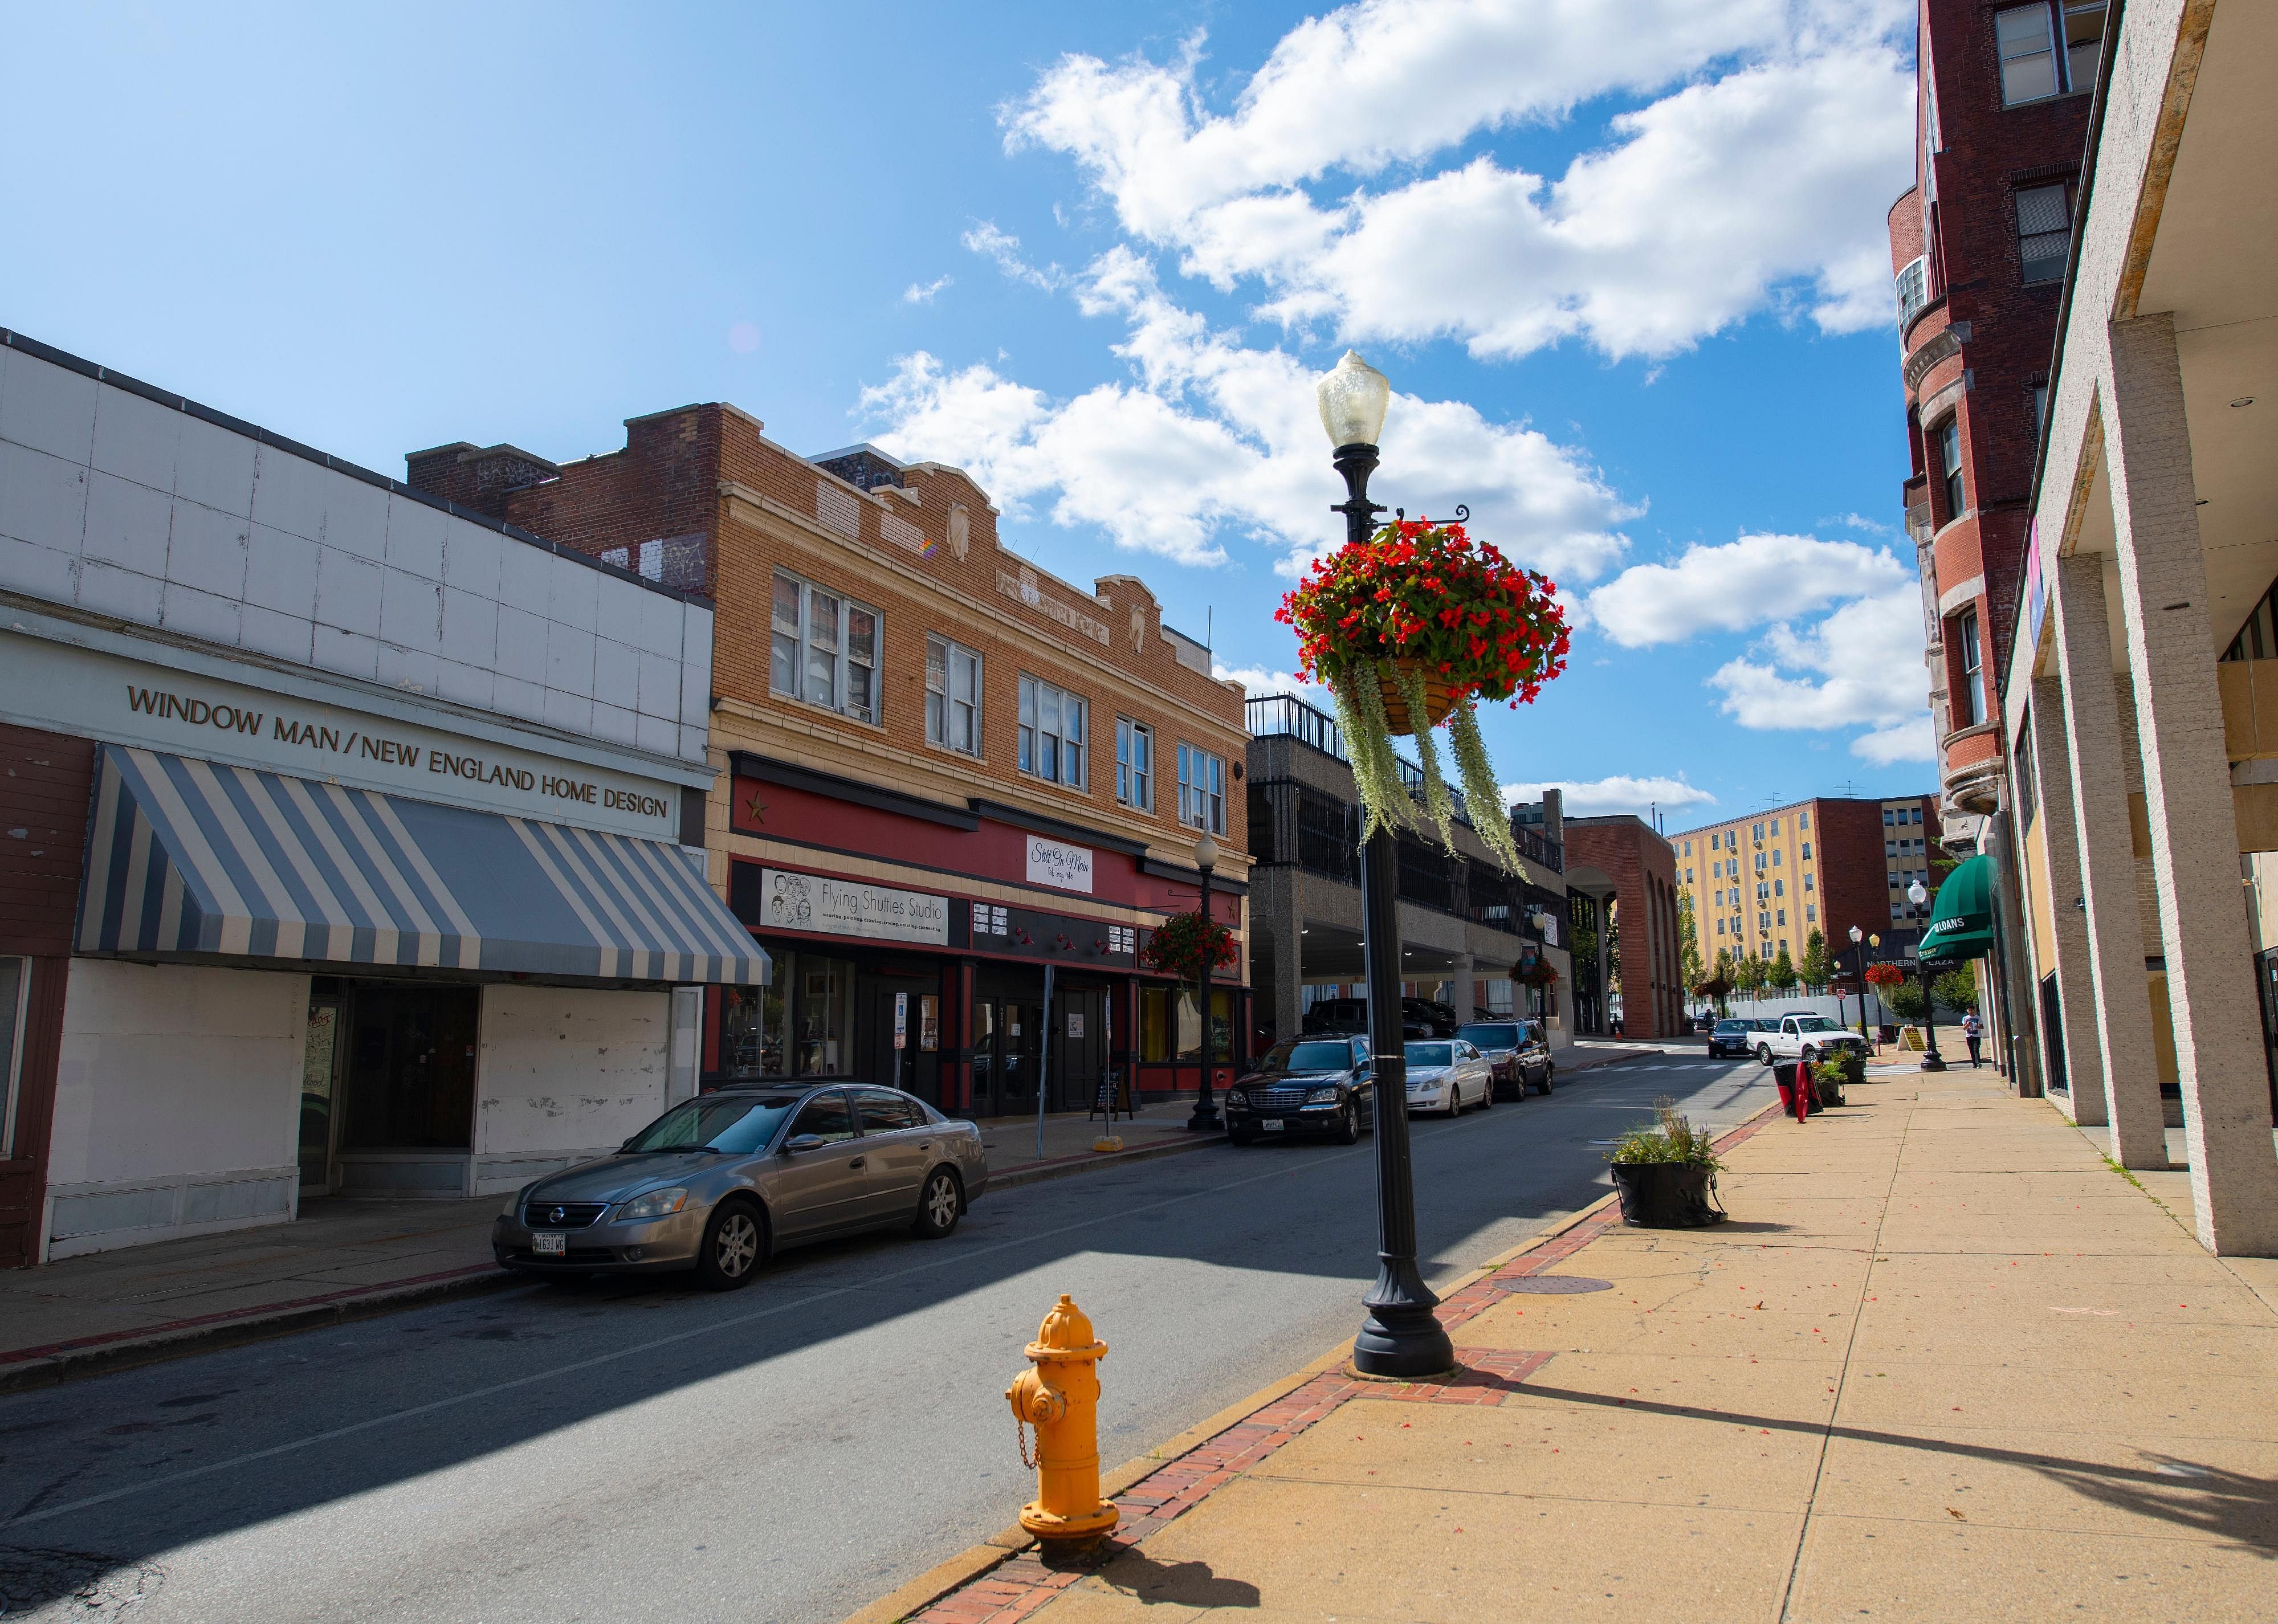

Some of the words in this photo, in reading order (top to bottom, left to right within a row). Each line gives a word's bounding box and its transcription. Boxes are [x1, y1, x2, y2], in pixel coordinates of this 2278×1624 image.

[127, 684, 263, 735] WINDOW
[429, 750, 535, 791] ENGLAND
[541, 774, 597, 804] HOME
[604, 788, 667, 818] DESIGN
[1031, 843, 1052, 863] Still
[1053, 848, 1065, 866] On
[1066, 850, 1089, 873] Main
[822, 884, 857, 914] Flying
[862, 890, 904, 915] Shuttles
[908, 897, 942, 920] Studio
[1939, 917, 1965, 931] LOANS
[1867, 959, 1916, 968] NRTHERN
